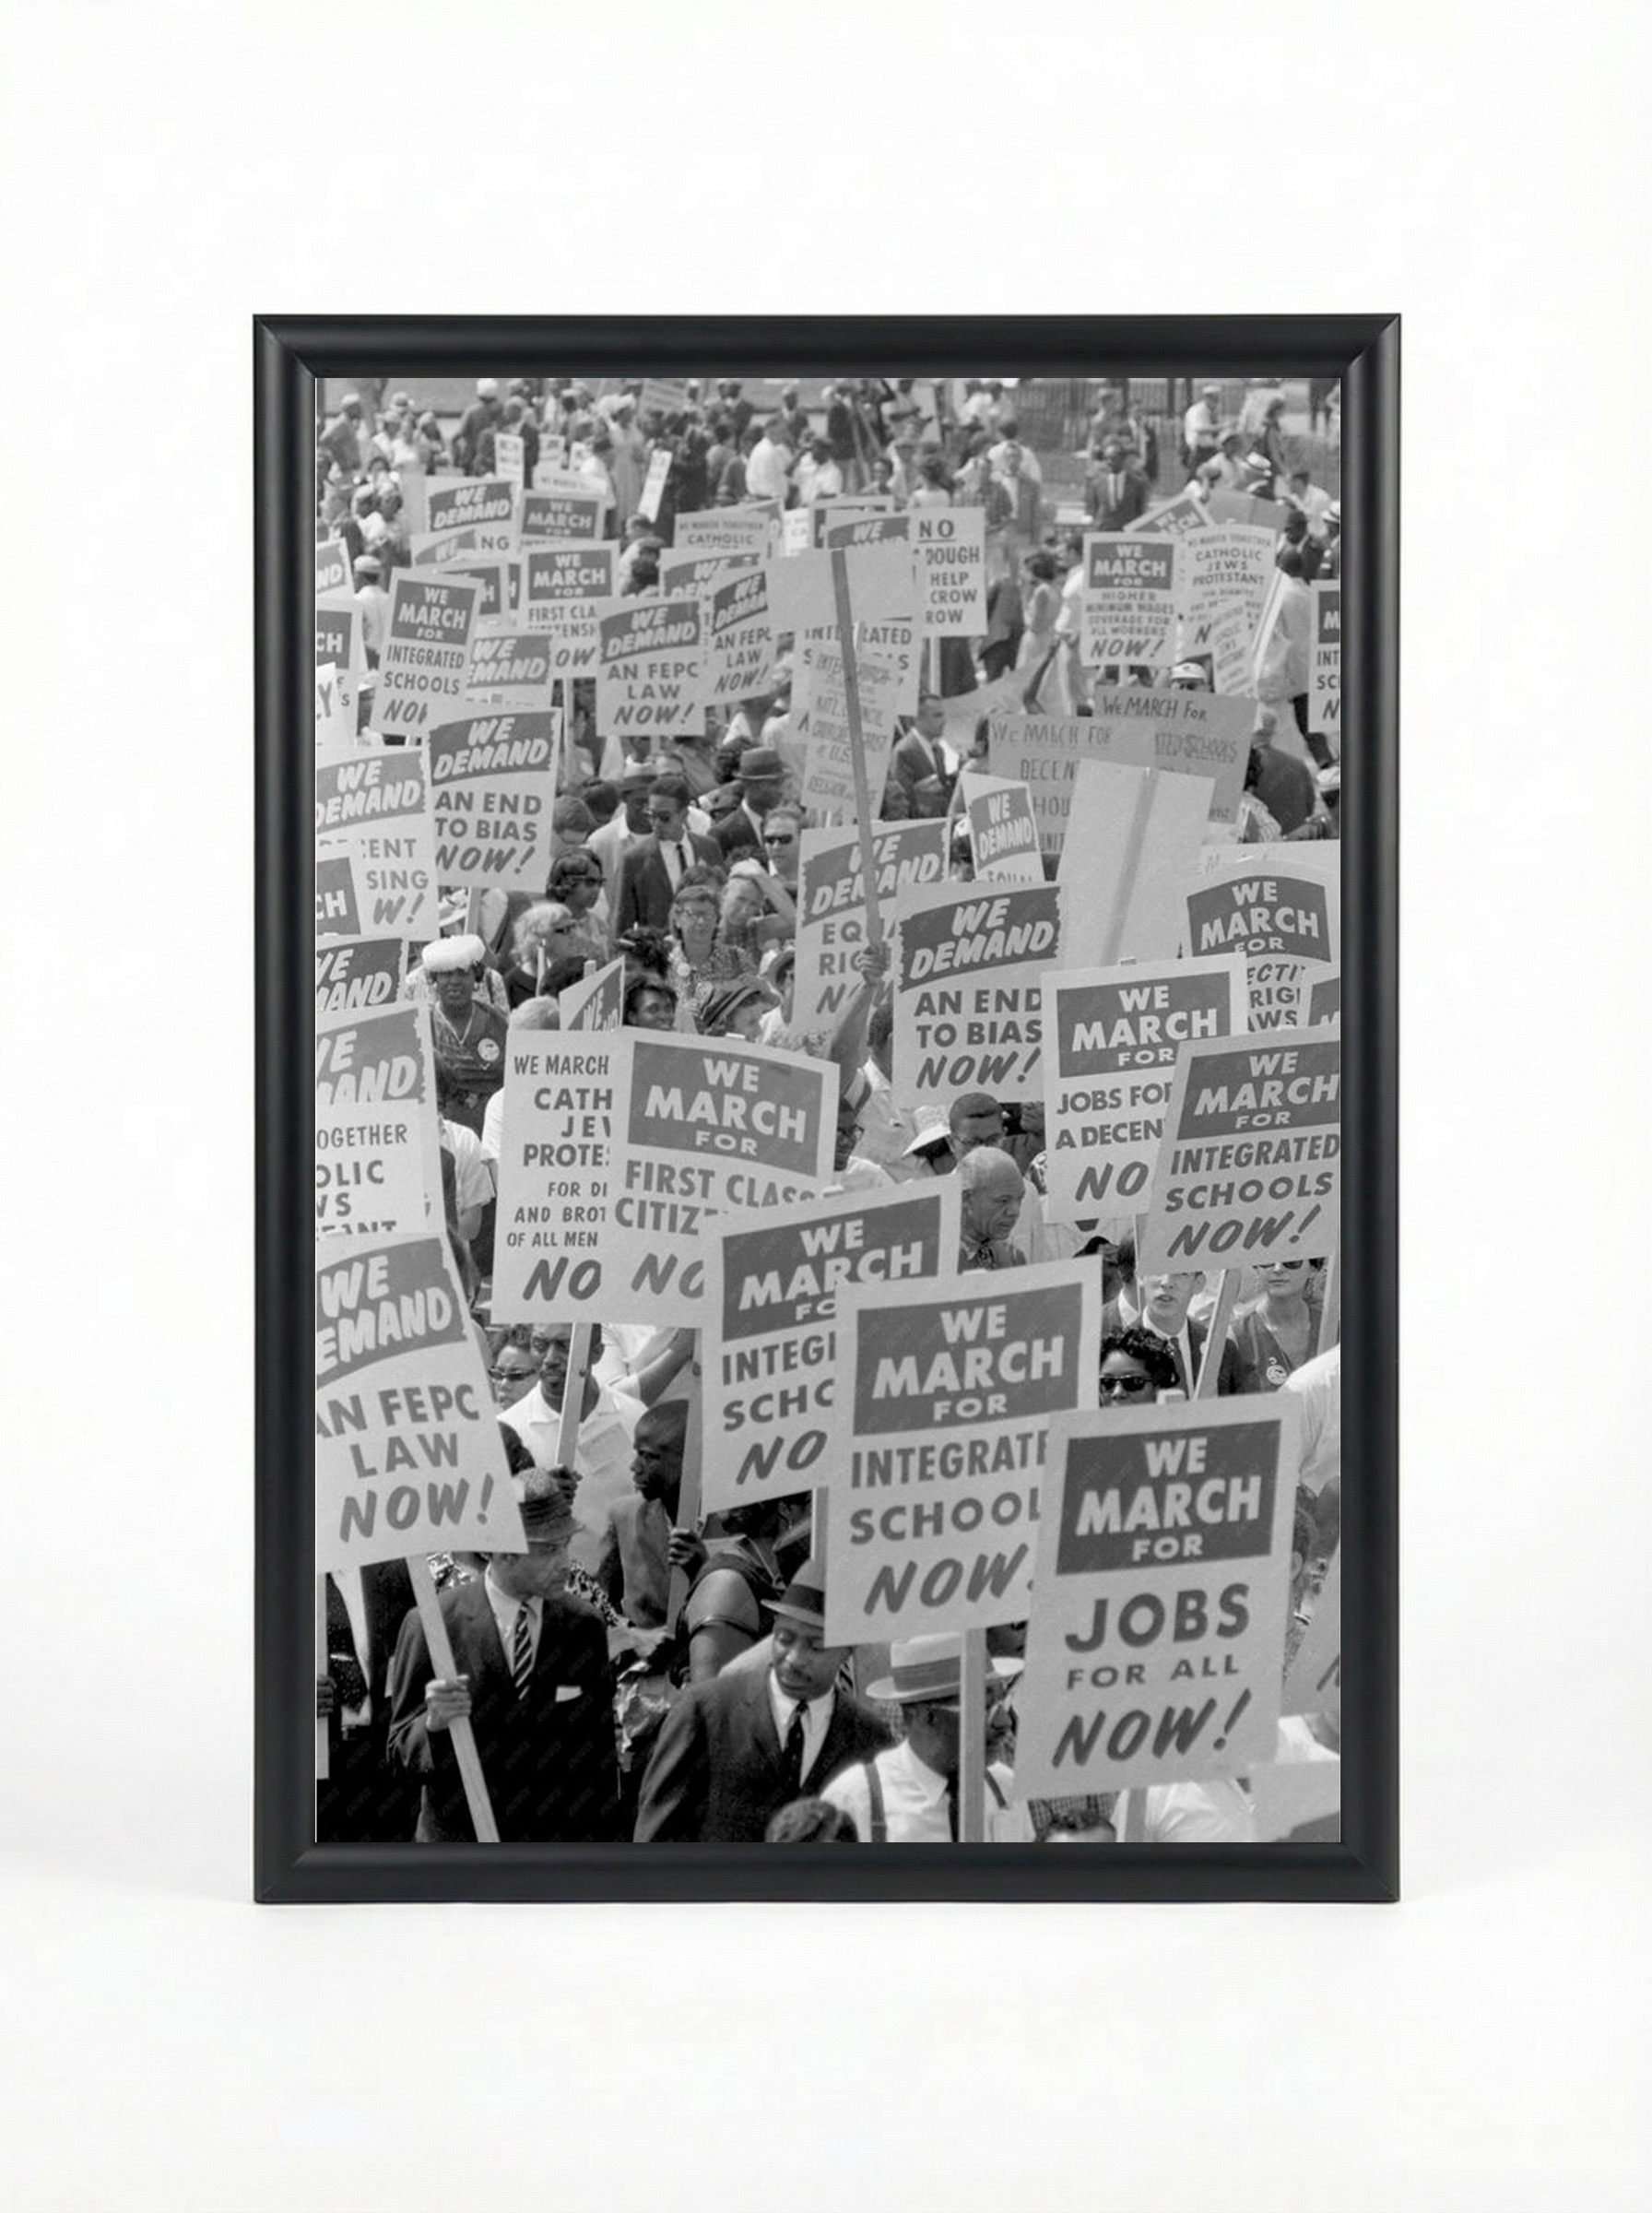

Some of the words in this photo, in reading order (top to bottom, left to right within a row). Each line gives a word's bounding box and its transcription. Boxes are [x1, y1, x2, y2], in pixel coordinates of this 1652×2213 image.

[455, 486, 487, 505] WE
[550, 501, 572, 513] WE
[434, 500, 509, 529] DEMAND
[527, 513, 592, 528] MARCH
[687, 534, 755, 545] CATHOLIC
[919, 519, 955, 538] NO
[555, 554, 582, 568] WE
[1116, 544, 1143, 558] WE
[1195, 548, 1263, 562] CATHOLIC
[533, 568, 607, 588] MARCH
[930, 572, 969, 586] HELP
[1093, 559, 1167, 576] MARCH
[1193, 573, 1264, 586] PROTESTANT
[1207, 561, 1247, 572] JEWS
[425, 586, 449, 605] WE
[554, 587, 584, 598] FOR
[929, 589, 978, 605] CROW
[398, 603, 466, 630] MARCH
[528, 607, 564, 621] FIRST
[570, 605, 597, 620] CLA
[631, 607, 668, 631] WE
[926, 609, 963, 624] ROW
[417, 627, 444, 640] FOR
[605, 621, 697, 658] DEMAND
[714, 635, 736, 650] AN
[386, 645, 465, 669] INTEGRATED
[472, 638, 517, 661] WE
[555, 646, 596, 668] OW
[726, 649, 762, 669] LAW
[1091, 638, 1165, 658] NOW!
[384, 671, 460, 695] SCHOOLS
[608, 663, 638, 680] AN
[648, 661, 699, 680] FEPC
[714, 664, 770, 694] NOW!
[628, 684, 681, 700] LAW
[613, 702, 695, 725] NOW!
[1122, 696, 1178, 719] MARCH
[467, 716, 516, 746] WE
[432, 738, 549, 780] DEMAND
[1021, 758, 1076, 781] DECEN
[336, 759, 383, 793] WE
[434, 791, 474, 812] AN
[483, 792, 543, 815] END
[988, 793, 1011, 824] WE
[434, 817, 468, 838] TO
[475, 820, 537, 843] BIAS
[978, 815, 1033, 861] DEMAND
[435, 844, 536, 875] NOW!
[367, 870, 429, 890] SING
[1231, 881, 1278, 906] WE
[951, 897, 1011, 937] WE
[1200, 906, 1319, 952] MARCH
[909, 920, 1055, 980] DEMAND
[1234, 936, 1286, 953] FOR
[914, 989, 962, 1017] AN
[974, 988, 1042, 1013] END
[1117, 985, 1170, 1012] WE
[916, 1023, 957, 1049] TO
[967, 1018, 1043, 1046] BIAS
[1071, 1008, 1218, 1052] MARCH
[513, 1054, 539, 1075] WE
[546, 1054, 609, 1076] MARCH
[915, 1046, 1042, 1089] NOW!
[1117, 1047, 1174, 1067] FOR
[1249, 1051, 1299, 1078] WE
[703, 1057, 761, 1093] WE
[534, 1087, 613, 1111] CATH
[1056, 1087, 1122, 1115] JOBS
[1194, 1073, 1340, 1117] MARCH
[643, 1084, 807, 1143] MARCH
[1235, 1110, 1292, 1130] FOR
[317, 1123, 408, 1150] OGETHER
[694, 1130, 759, 1156] FOR
[1056, 1128, 1077, 1151] A
[1080, 1118, 1165, 1148] DECEN
[523, 1142, 609, 1167] PROTE
[1170, 1132, 1340, 1176] INTEGRATED
[316, 1159, 385, 1189] OLIC
[625, 1159, 715, 1200] FIRST
[1074, 1160, 1149, 1202] NO
[548, 1181, 581, 1197] FOR
[1164, 1171, 1334, 1213] SCHOOLS
[513, 1206, 551, 1223] AND
[506, 1232, 526, 1248] OF
[531, 1231, 558, 1248] ALL
[563, 1231, 598, 1248] MEN
[800, 1219, 865, 1258] WE
[1166, 1203, 1322, 1259] NOW!
[321, 1254, 389, 1319] WE
[522, 1256, 602, 1301] NO
[738, 1241, 924, 1312] MARCH
[795, 1298, 836, 1321] FO
[316, 1286, 453, 1377] EMAND
[939, 1304, 1008, 1344] WE
[722, 1331, 836, 1386] INTEG
[872, 1334, 1065, 1401] MARCH
[378, 1383, 480, 1427] FEPC
[932, 1393, 1009, 1423] FOR
[349, 1433, 459, 1479] LAW
[736, 1429, 829, 1486] NO
[1144, 1436, 1208, 1478] WE
[339, 1473, 495, 1544] NOW!
[849, 1486, 1042, 1547] SCHOOL
[1075, 1475, 1263, 1538] MARCH
[1131, 1533, 1205, 1563] FOR
[1064, 1581, 1251, 1654] JOBS
[1066, 1664, 1147, 1692] FOR
[1170, 1654, 1241, 1683] ALL
[1052, 1686, 1253, 1769] NOW!
